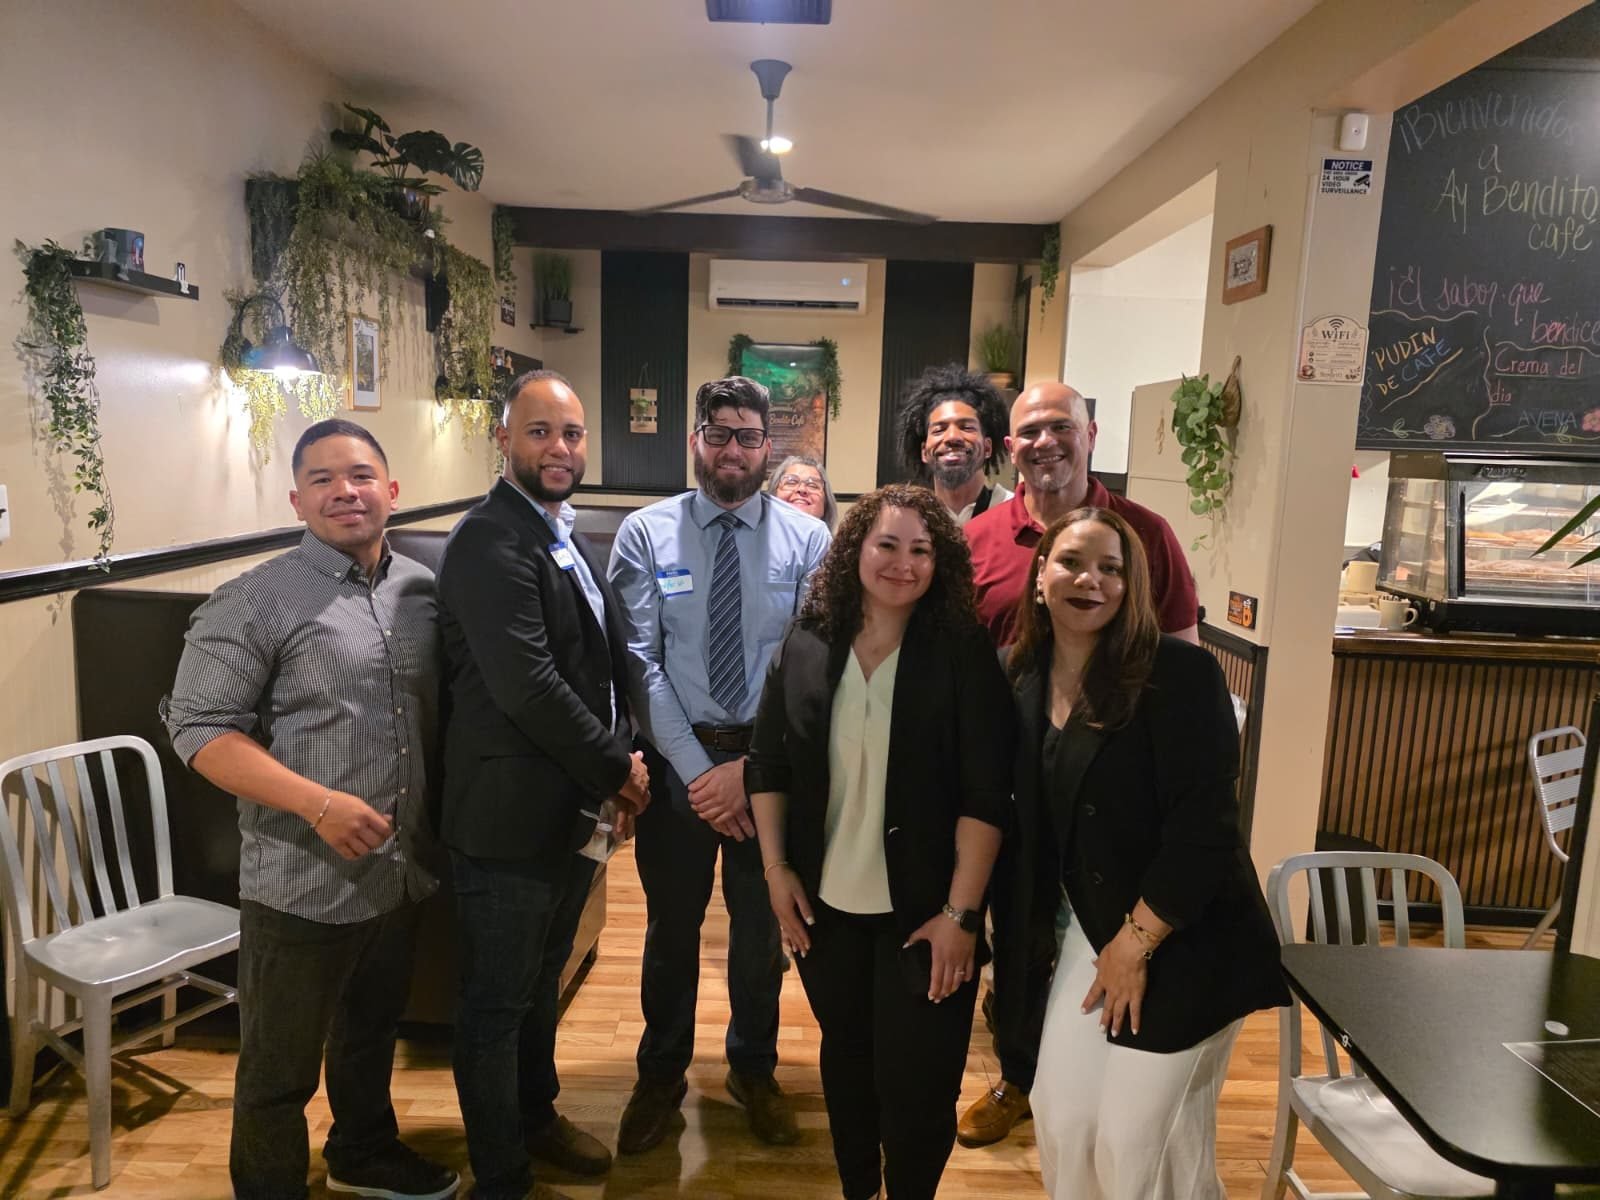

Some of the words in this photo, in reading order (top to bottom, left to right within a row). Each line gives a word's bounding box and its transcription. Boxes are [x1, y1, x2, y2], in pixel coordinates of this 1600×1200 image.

[1331, 161, 1365, 170] NOTICE
[1478, 143, 1502, 173] a
[1433, 168, 1468, 235] Ay
[1483, 174, 1599, 222] Bendito
[1507, 280, 1551, 326] que
[1375, 326, 1437, 372] PUDIN
[1376, 374, 1400, 396] DE
[1401, 338, 1452, 382] CAFE
[1495, 345, 1549, 375] Crema
[1559, 350, 1584, 376] del
[1518, 409, 1578, 429] AVENA
